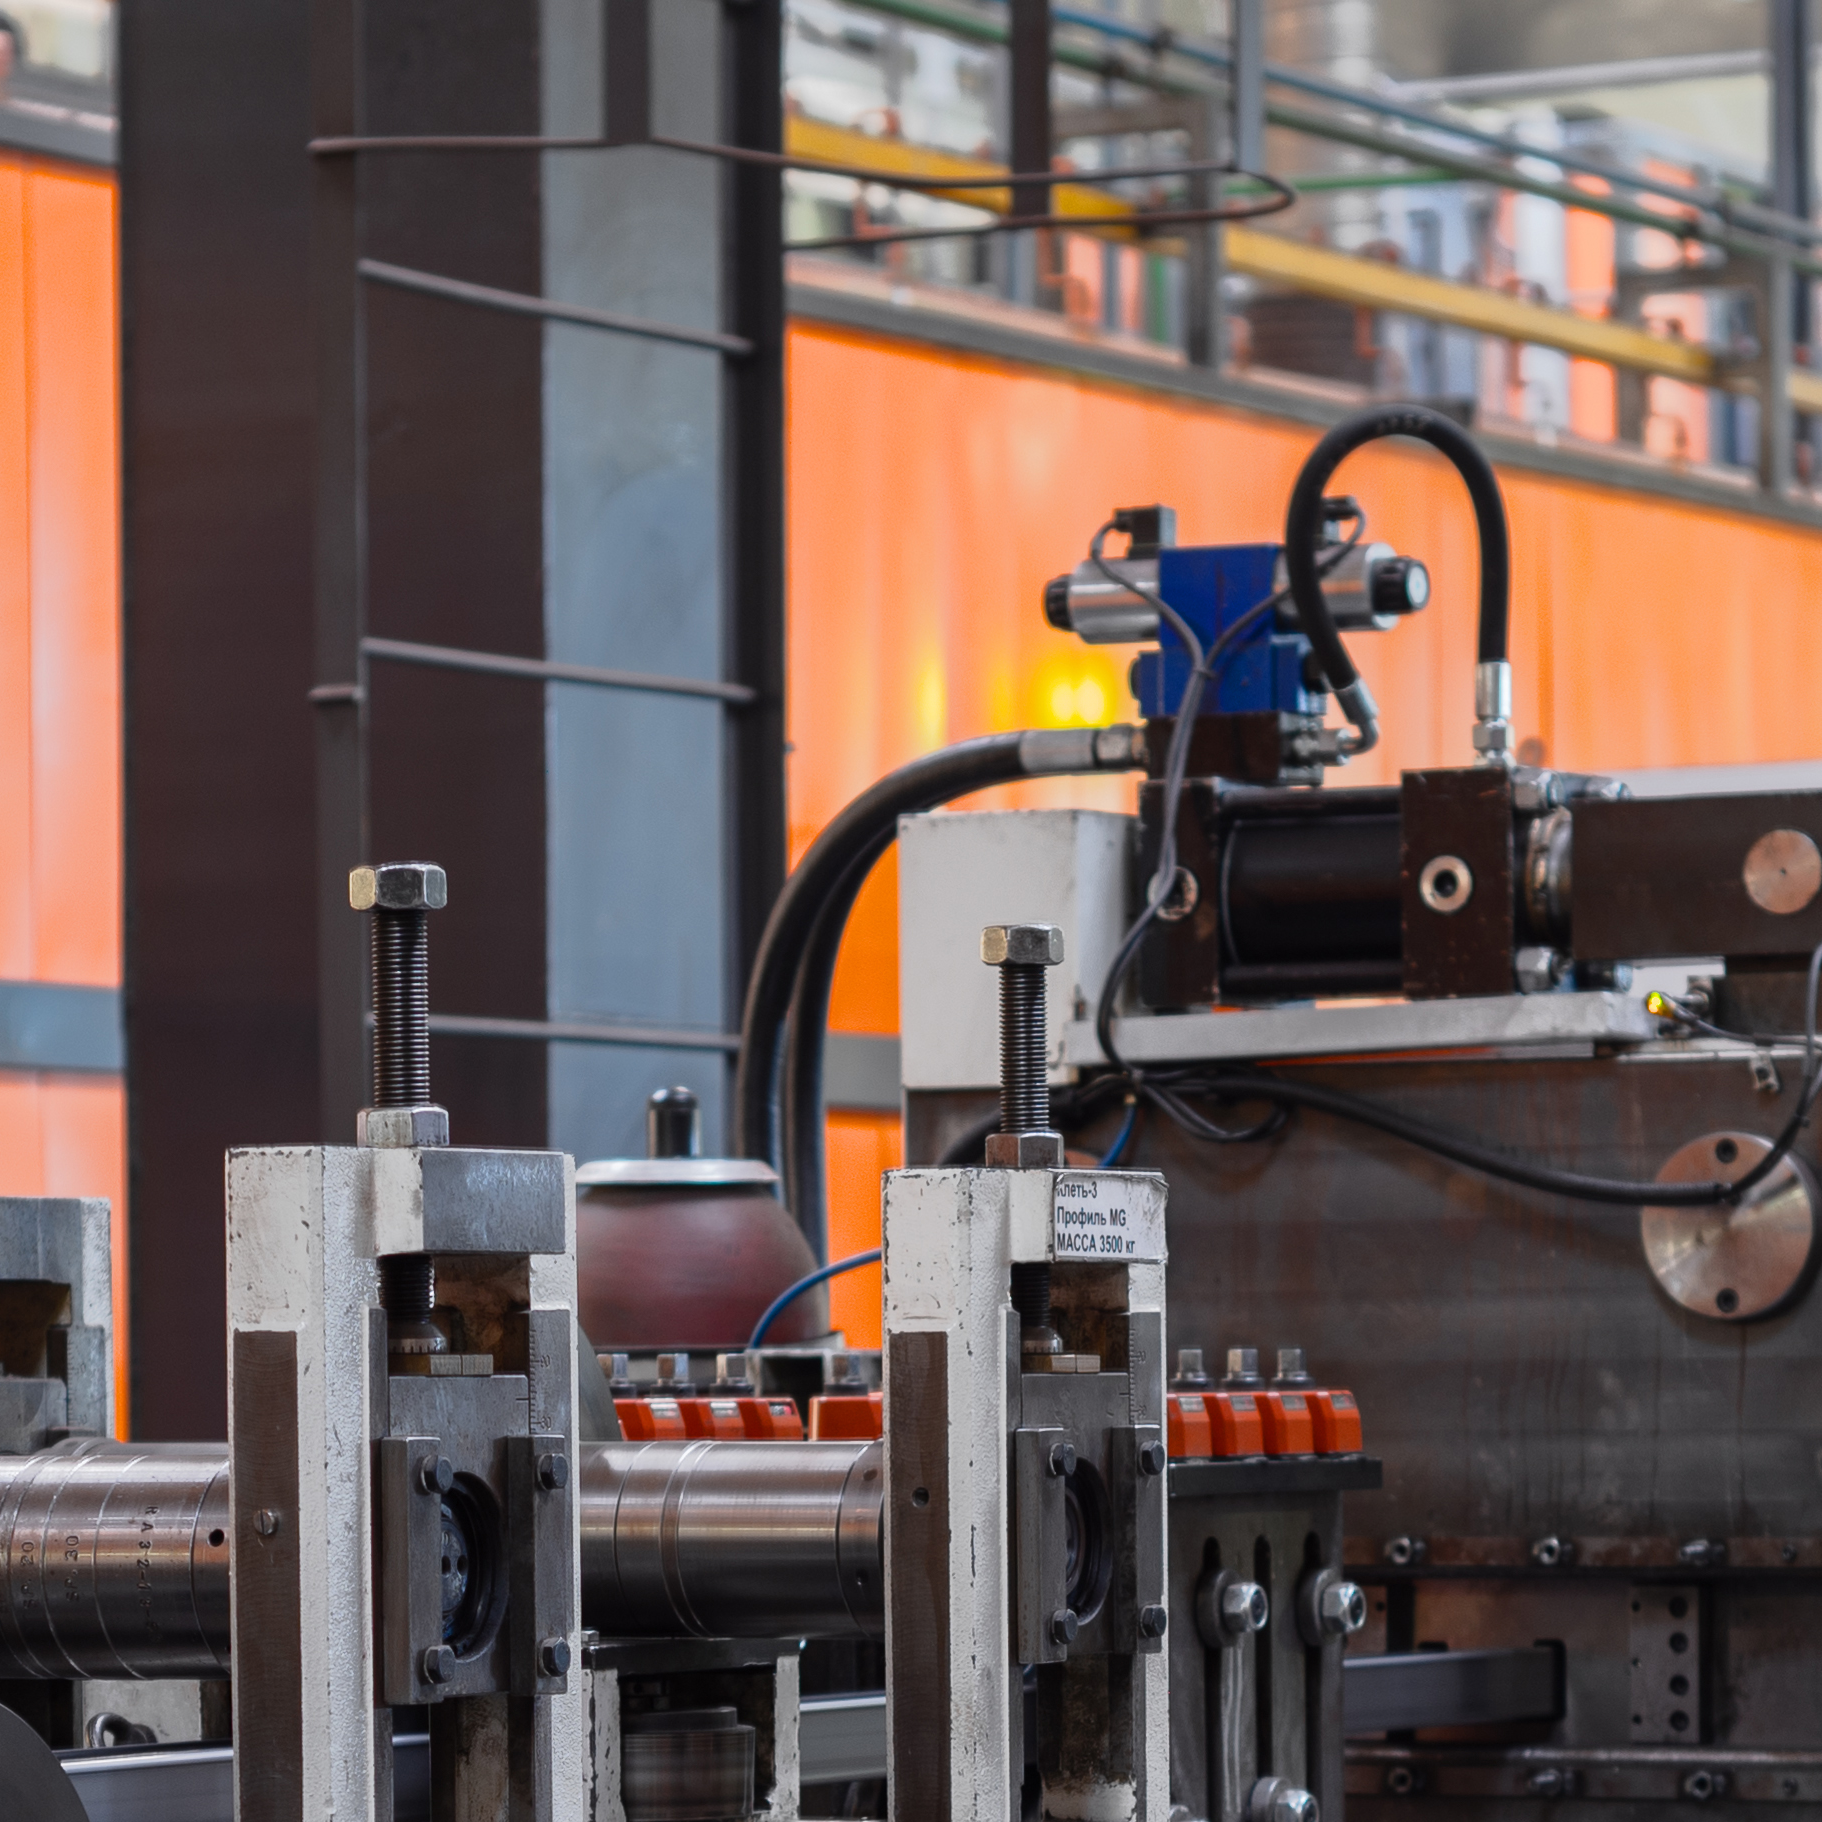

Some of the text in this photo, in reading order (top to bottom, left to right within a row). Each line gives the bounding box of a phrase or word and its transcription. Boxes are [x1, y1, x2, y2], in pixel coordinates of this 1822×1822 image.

[1057, 1206, 1126, 1229] Профиль MG
[1057, 1232, 1136, 1253] МАССА 3500 кг
[20, 1539, 36, 1567] 20
[64, 1534, 80, 1563] 30
